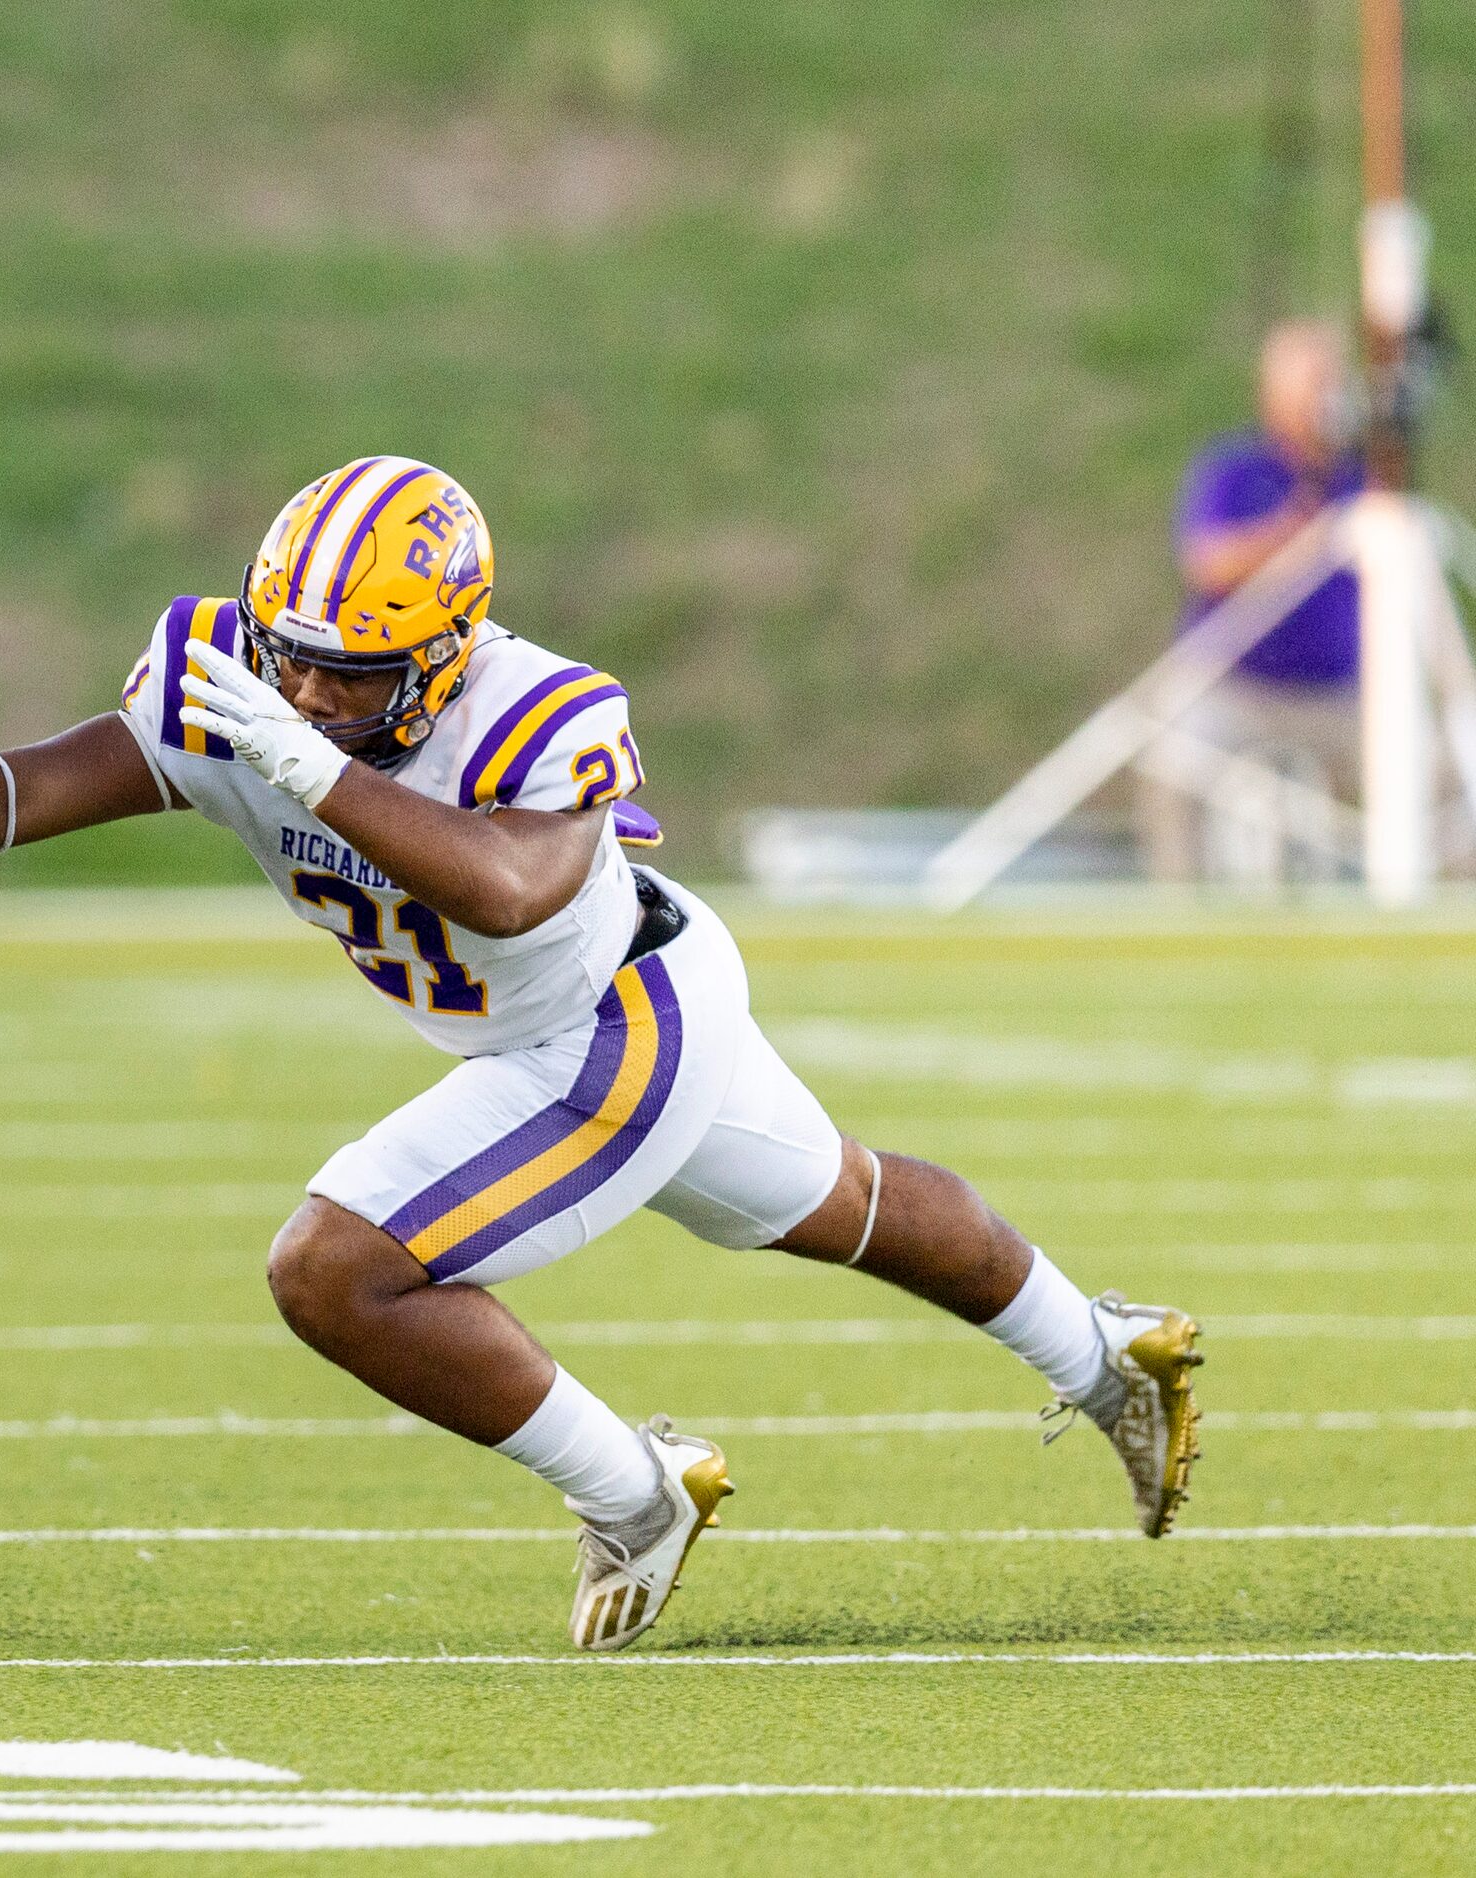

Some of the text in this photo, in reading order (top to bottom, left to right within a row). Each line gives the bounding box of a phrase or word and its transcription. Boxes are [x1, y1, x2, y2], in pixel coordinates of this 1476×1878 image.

[404, 486, 466, 580] RHS
[569, 726, 647, 810] 21
[290, 868, 490, 1017] 21
